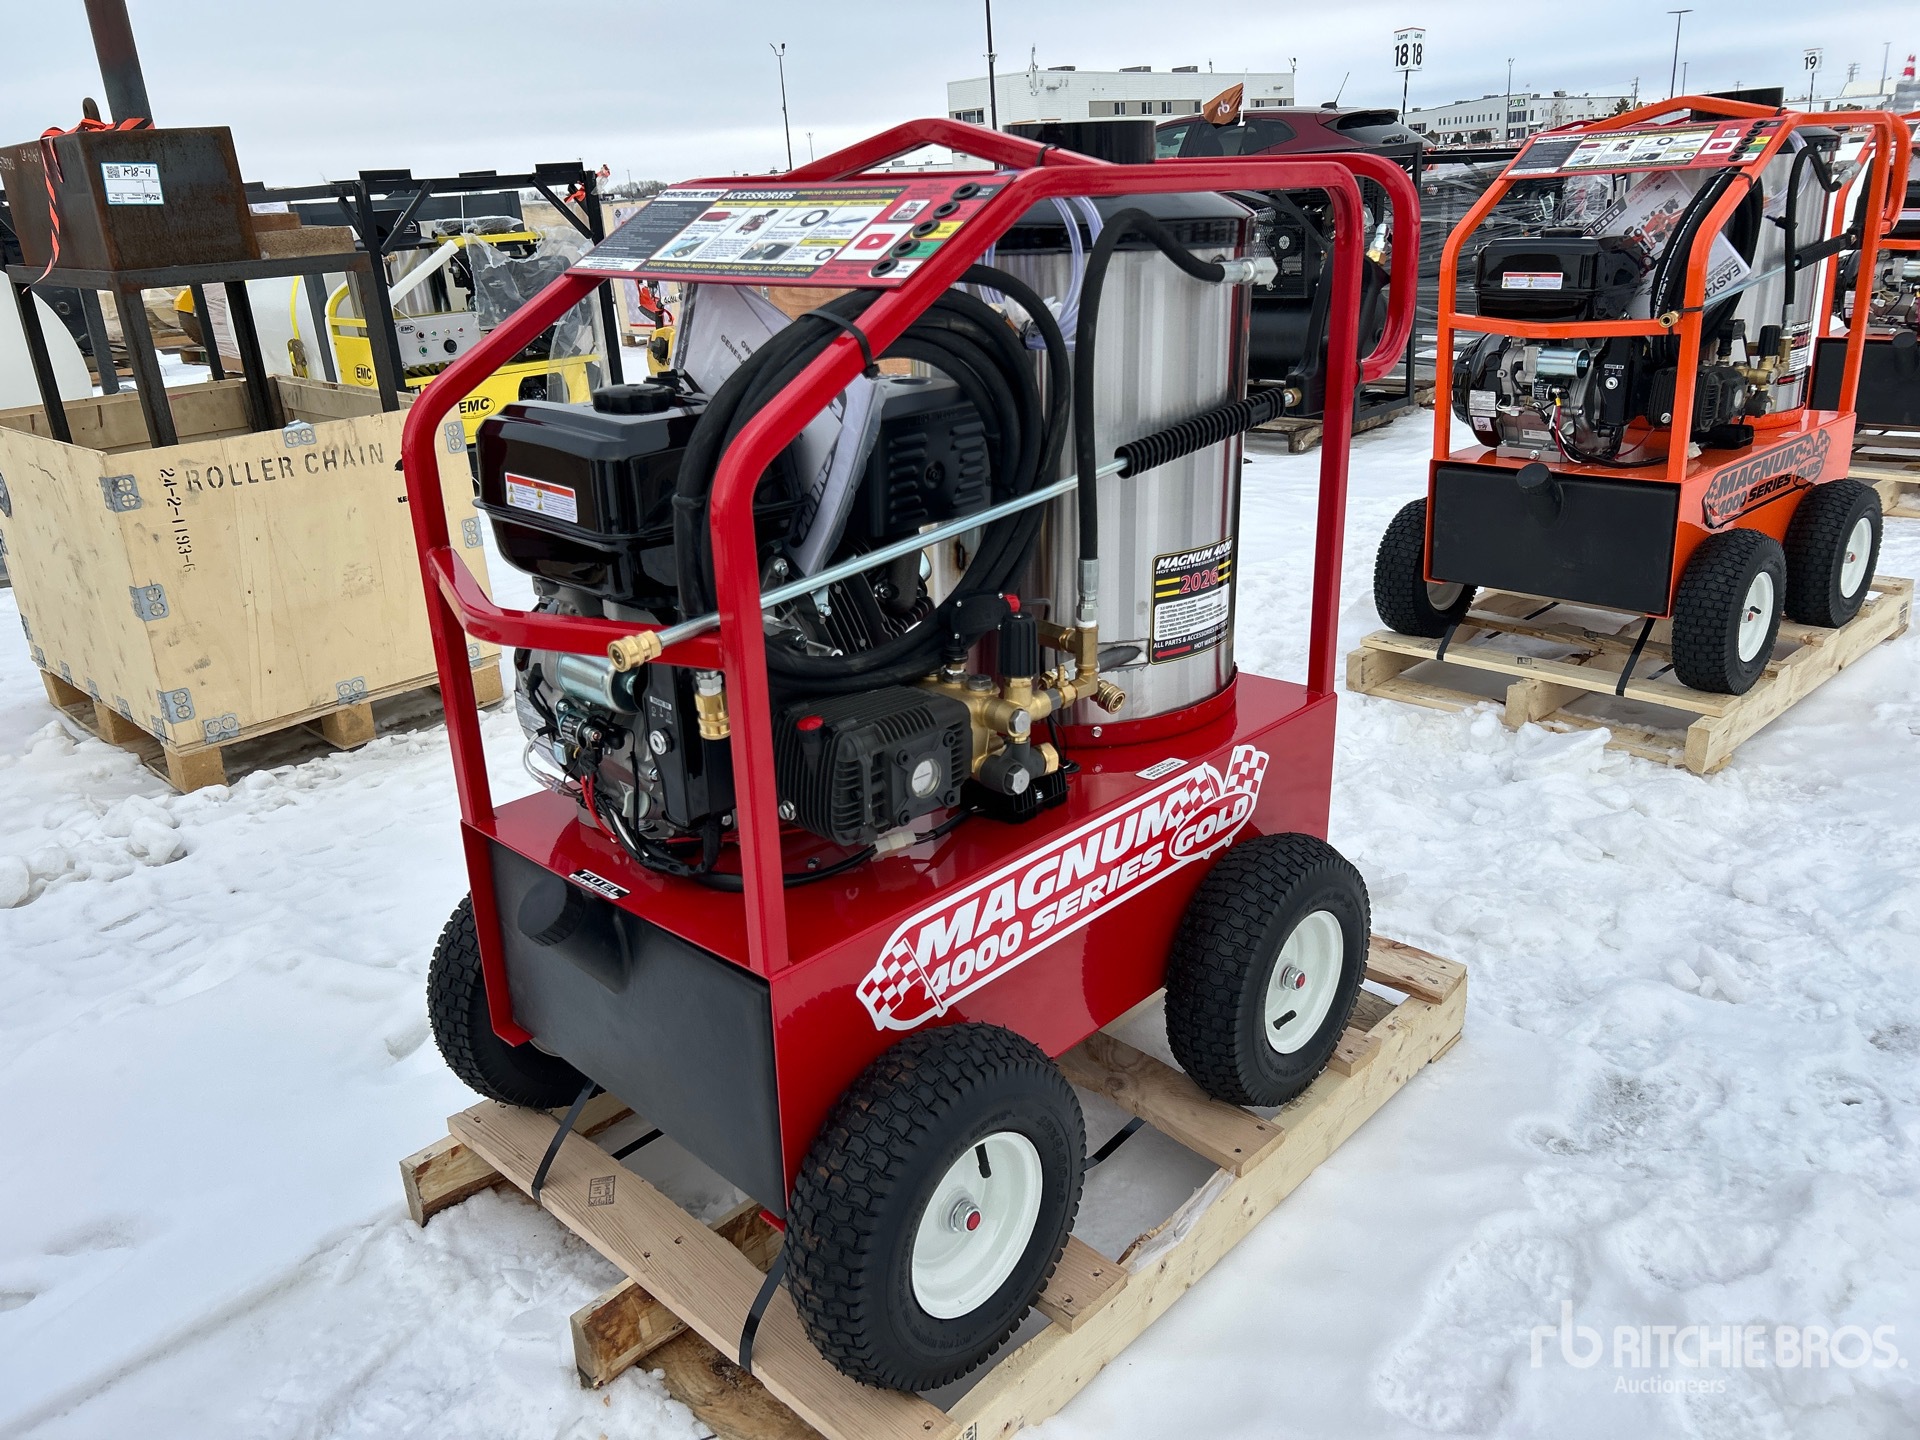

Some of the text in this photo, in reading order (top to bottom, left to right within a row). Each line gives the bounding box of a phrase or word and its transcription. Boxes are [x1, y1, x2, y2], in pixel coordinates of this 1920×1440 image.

[1397, 32, 1408, 40] Lane
[1395, 43, 1409, 67] 18
[1412, 42, 1423, 66] 18
[1804, 55, 1817, 70] 19
[1586, 131, 1640, 139] ACCESSORIES
[723, 190, 796, 200] ACCESSORIES
[1704, 263, 1742, 300] EASY-K
[356, 367, 372, 380] EMC
[458, 397, 490, 414] EMC
[185, 442, 384, 492] ROLLER CHAIN
[1717, 443, 1803, 499] MAGNUM
[1795, 460, 1821, 483] PLUS
[1719, 472, 1792, 516] 4000 SERIES
[1156, 547, 1213, 571] MAGNUM
[1170, 564, 1191, 573] WATER
[1180, 566, 1219, 594] 2026
[1153, 641, 1164, 649] ALL
[1164, 636, 1182, 647] PARTS
[1187, 627, 1214, 641] ACCESSORIES
[1175, 797, 1247, 851] GOLD
[580, 872, 619, 896] FUEL
[916, 787, 1193, 966] MAGNUM
[923, 841, 1165, 1001] 4000 SERIES
